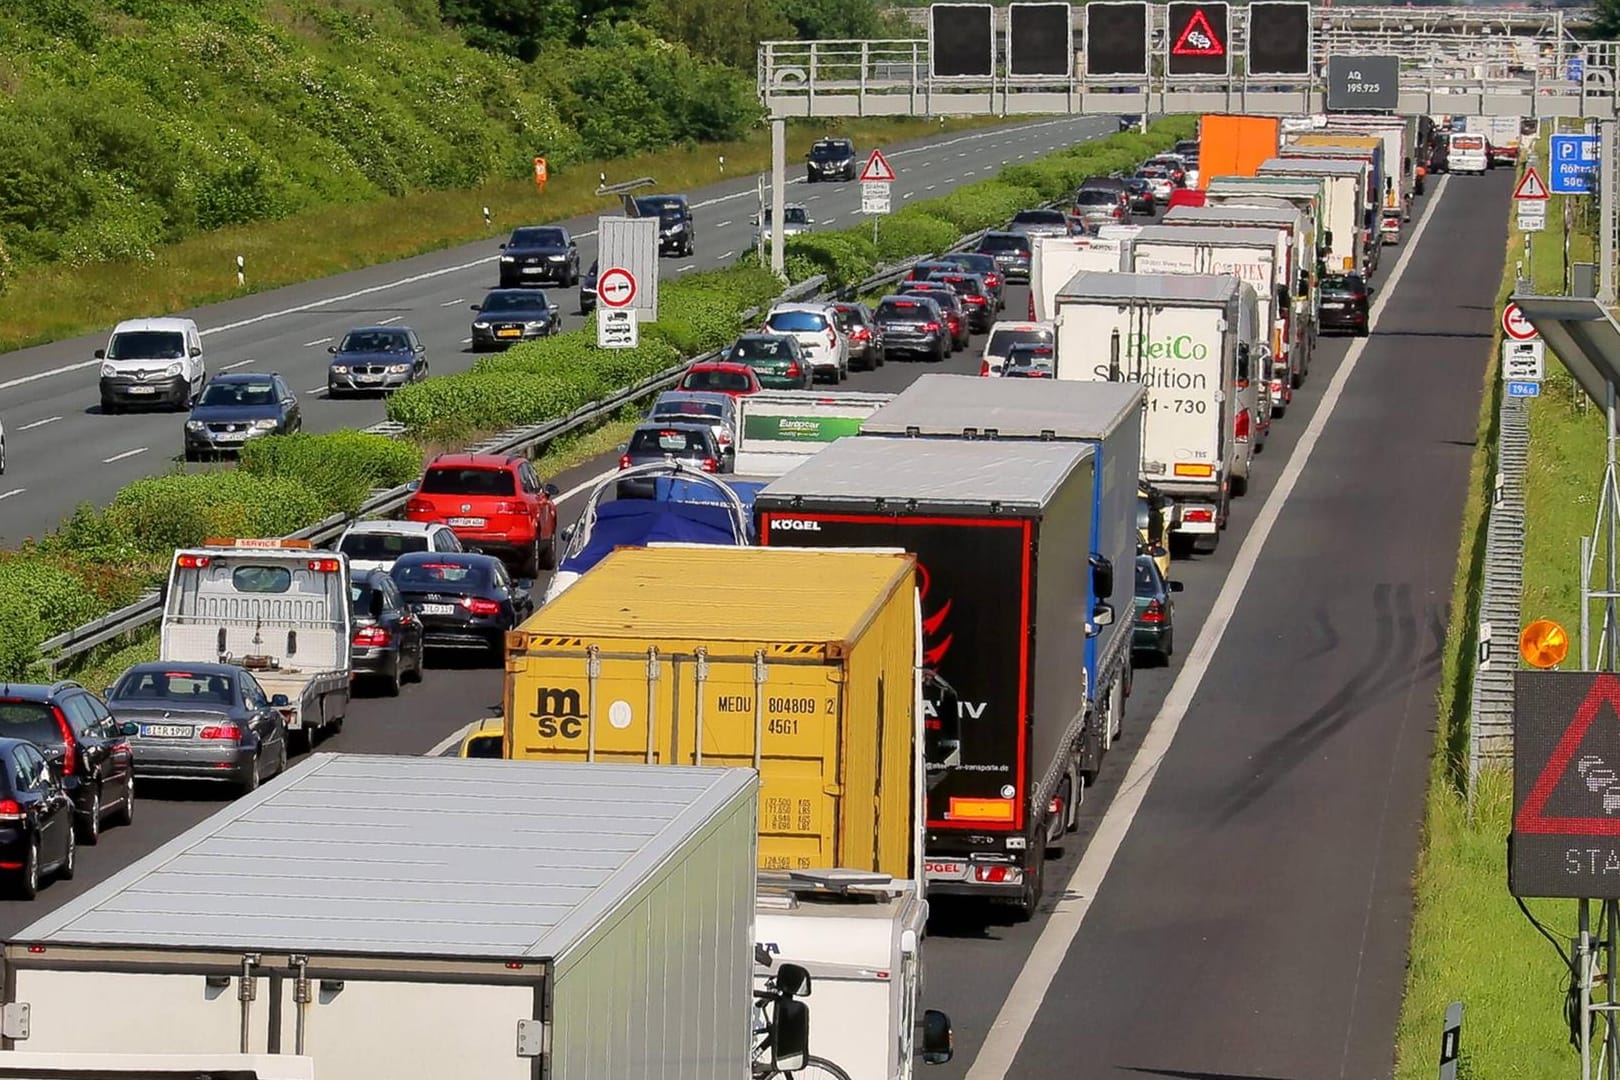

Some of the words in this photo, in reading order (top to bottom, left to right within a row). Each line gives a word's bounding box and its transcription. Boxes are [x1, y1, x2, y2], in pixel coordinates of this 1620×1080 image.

[1347, 71, 1361, 80] AQ
[1562, 143, 1573, 158] P
[1125, 333, 1207, 360] ReiCo
[1174, 400, 1206, 414] 730
[779, 419, 820, 429] Europcar
[771, 519, 821, 531] KÖGEL
[718, 696, 751, 712] MEDU
[769, 698, 815, 714] 804809
[826, 699, 834, 715] 2
[768, 719, 798, 735] 45G1
